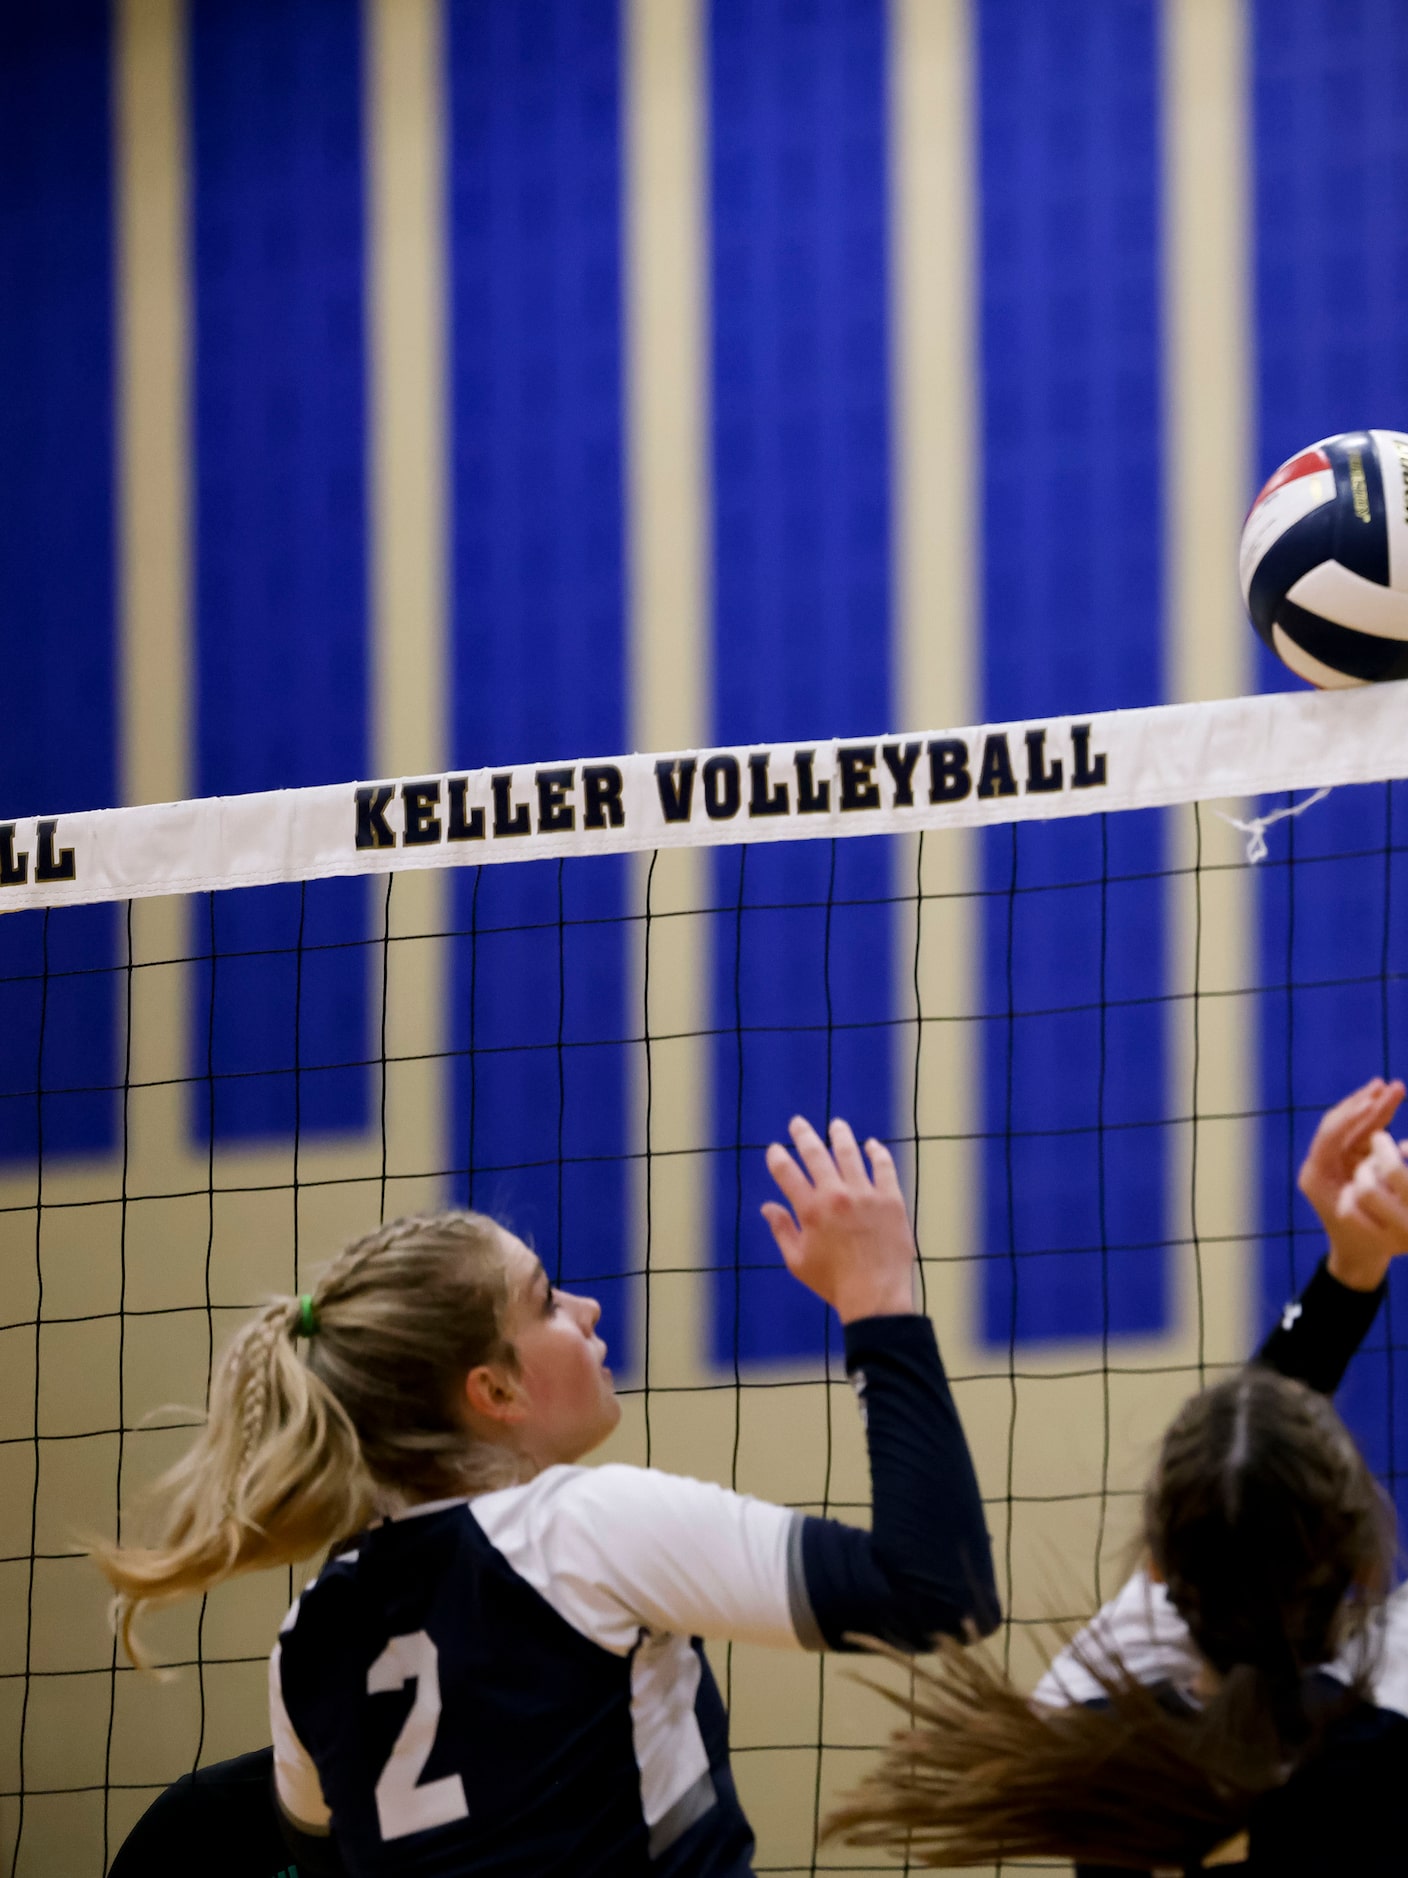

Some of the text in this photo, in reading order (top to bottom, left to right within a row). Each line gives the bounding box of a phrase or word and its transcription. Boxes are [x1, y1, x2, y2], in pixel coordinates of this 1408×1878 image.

[354, 724, 1107, 851] KELLER VOLLEYBALL
[367, 1629, 470, 1841] 2
